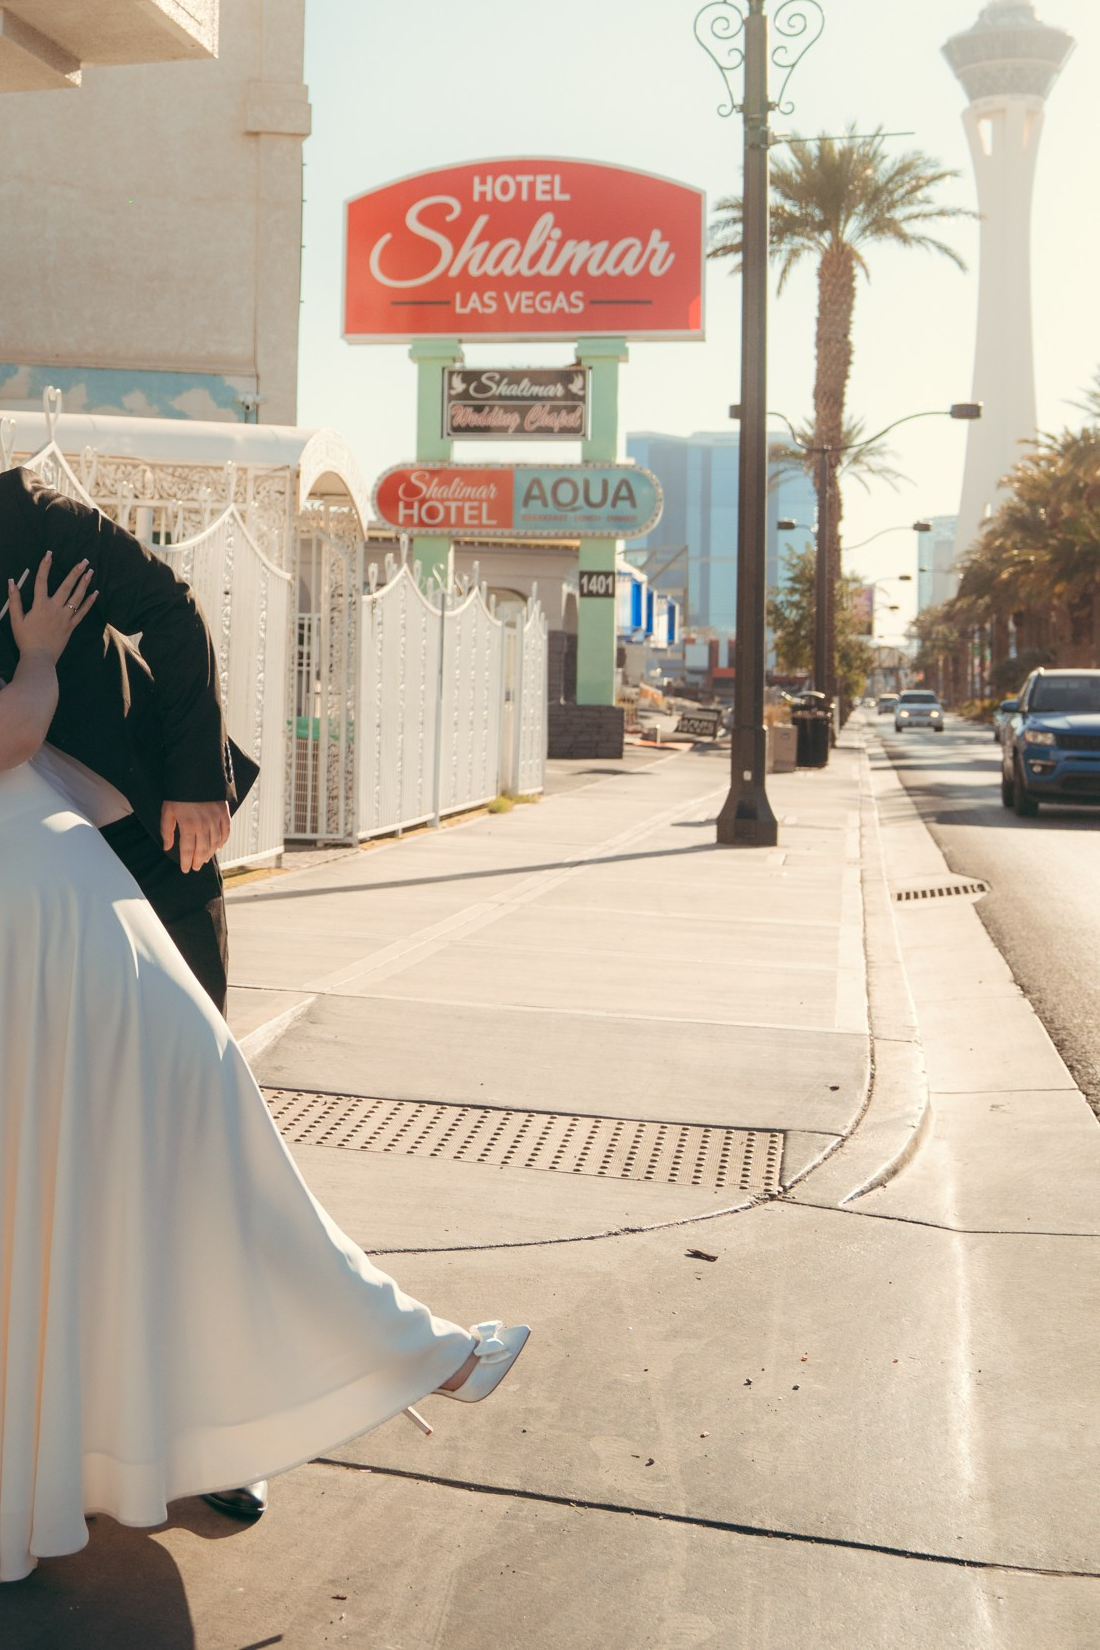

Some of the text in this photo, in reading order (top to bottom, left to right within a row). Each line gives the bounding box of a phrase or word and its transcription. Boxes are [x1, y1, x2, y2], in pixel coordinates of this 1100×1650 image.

[472, 174, 570, 201] HOTEL
[369, 195, 675, 288] Shalimar
[455, 291, 584, 314] LAS VEGAS
[468, 371, 565, 399] Shalimar
[451, 403, 581, 433] Wedding Chapel
[398, 470, 498, 500] Shalimar
[521, 477, 638, 513] AQUA
[399, 501, 497, 526] HOTEL
[580, 574, 614, 594] 1401
